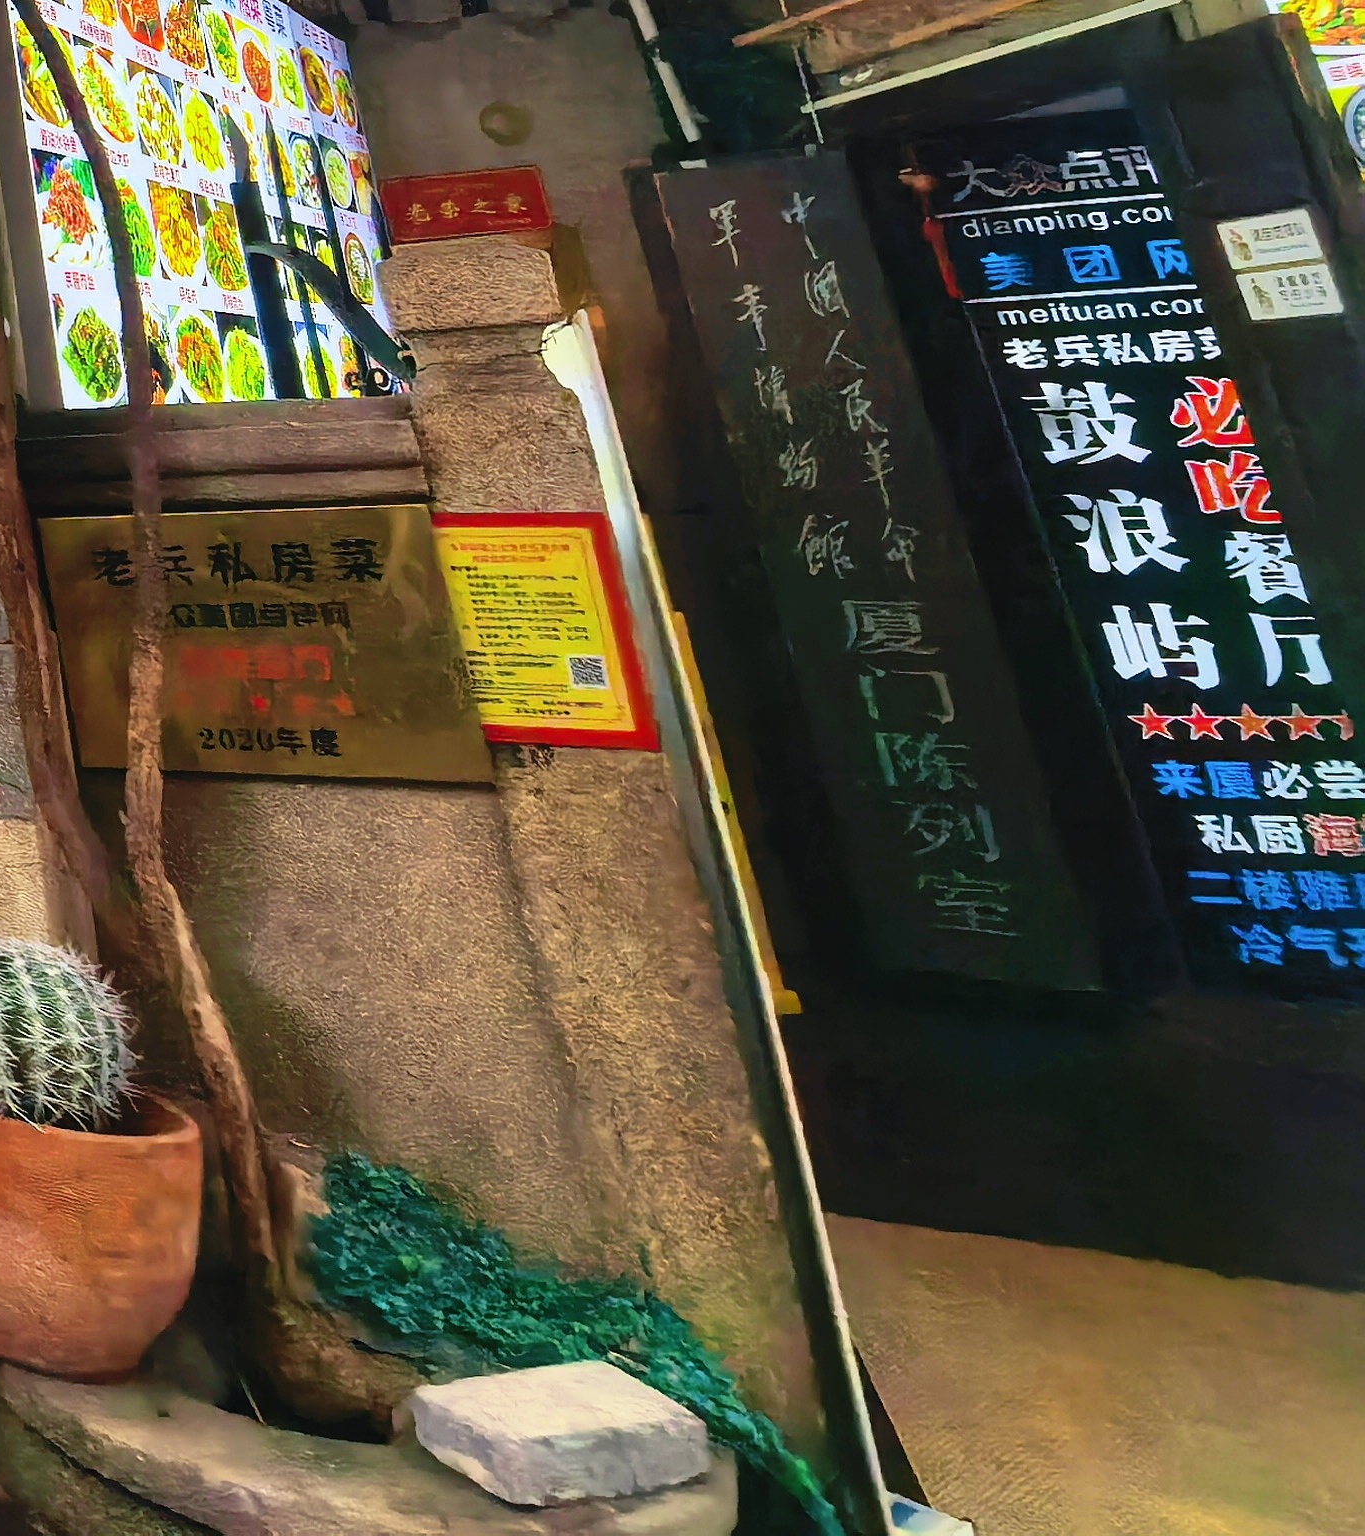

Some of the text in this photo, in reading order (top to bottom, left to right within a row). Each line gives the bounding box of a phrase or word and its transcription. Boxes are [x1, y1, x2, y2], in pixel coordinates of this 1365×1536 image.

[961, 205, 1173, 237] dianping.co
[1021, 381, 1221, 691] 鼓浪屿
[197, 727, 342, 758] 2020年度
